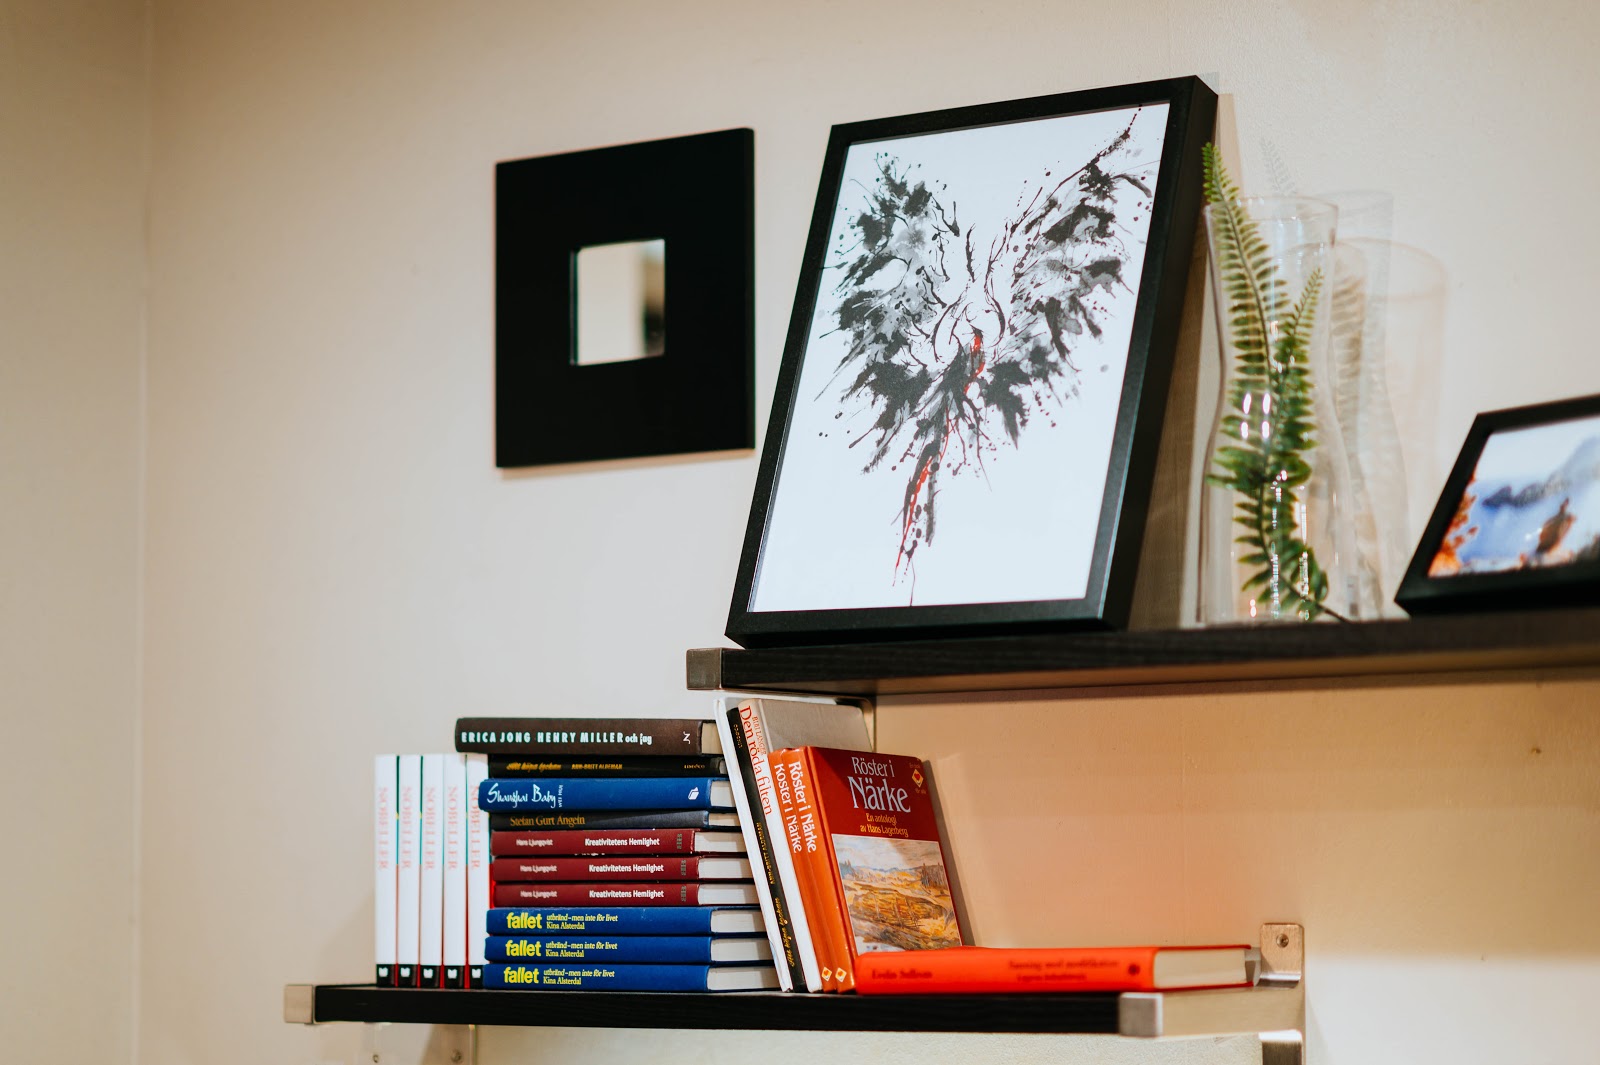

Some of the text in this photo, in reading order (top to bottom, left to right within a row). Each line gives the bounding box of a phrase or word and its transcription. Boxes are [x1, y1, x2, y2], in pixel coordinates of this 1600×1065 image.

[461, 731, 652, 745] ERICA JONG HENRY MILLER och jag
[739, 706, 773, 815] Den röda filten
[851, 756, 895, 778] Röster i
[486, 782, 556, 809] Shanghai Baby
[847, 775, 911, 813] Närke
[788, 761, 817, 853] Röster i Närke
[509, 815, 534, 827] Stefan
[535, 815, 555, 826] Gurt
[865, 813, 897, 825] En antologi
[786, 813, 802, 853] Närke
[867, 824, 881, 833] Hans
[881, 825, 909, 838] Lagerberg
[584, 837, 660, 847] Kreativitetens Hemlighet
[588, 863, 664, 873] Kreativitetens Hemlighet
[589, 890, 664, 900] Kreativitetens Hemlighet
[506, 911, 543, 929] fallet
[585, 913, 596, 922] inte
[596, 913, 605, 922] för
[605, 913, 618, 922] livet
[546, 922, 585, 930] Kina Alsterdal
[505, 939, 542, 957] fallet
[584, 941, 595, 950] inte
[595, 941, 605, 950] för
[605, 941, 618, 950] livet
[559, 950, 584, 958] Alsterdal
[503, 966, 539, 984] fallet
[581, 969, 593, 977] inte
[593, 969, 602, 977] för
[602, 969, 615, 978] livet
[543, 977, 581, 985] Kina Alsterdal
